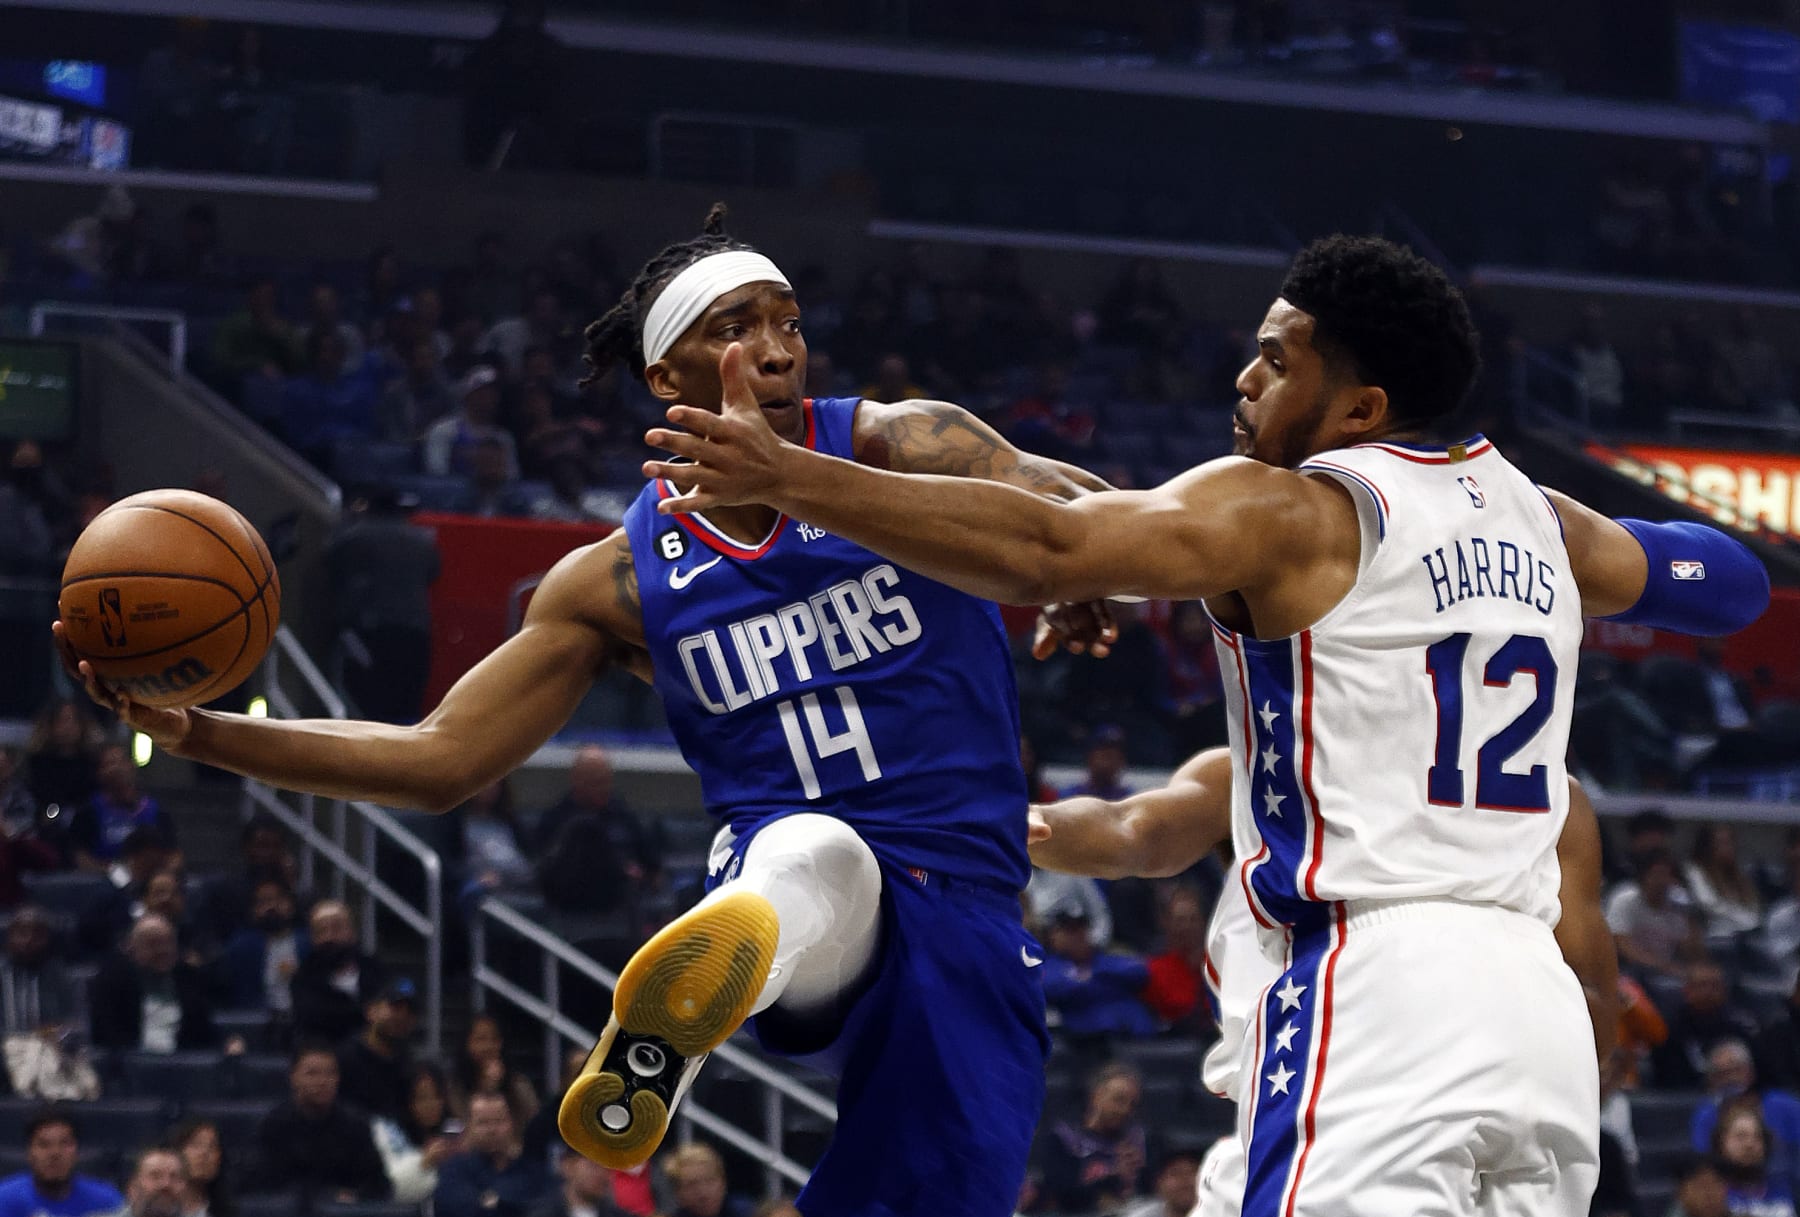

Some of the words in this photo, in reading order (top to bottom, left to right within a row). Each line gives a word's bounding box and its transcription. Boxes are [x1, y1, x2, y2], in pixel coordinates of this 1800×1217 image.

[660, 531, 685, 560] 6
[1422, 537, 1556, 616] HARRIS
[678, 564, 922, 715] CLIPPERS
[776, 686, 882, 800] 14
[1426, 632, 1559, 814] 12
